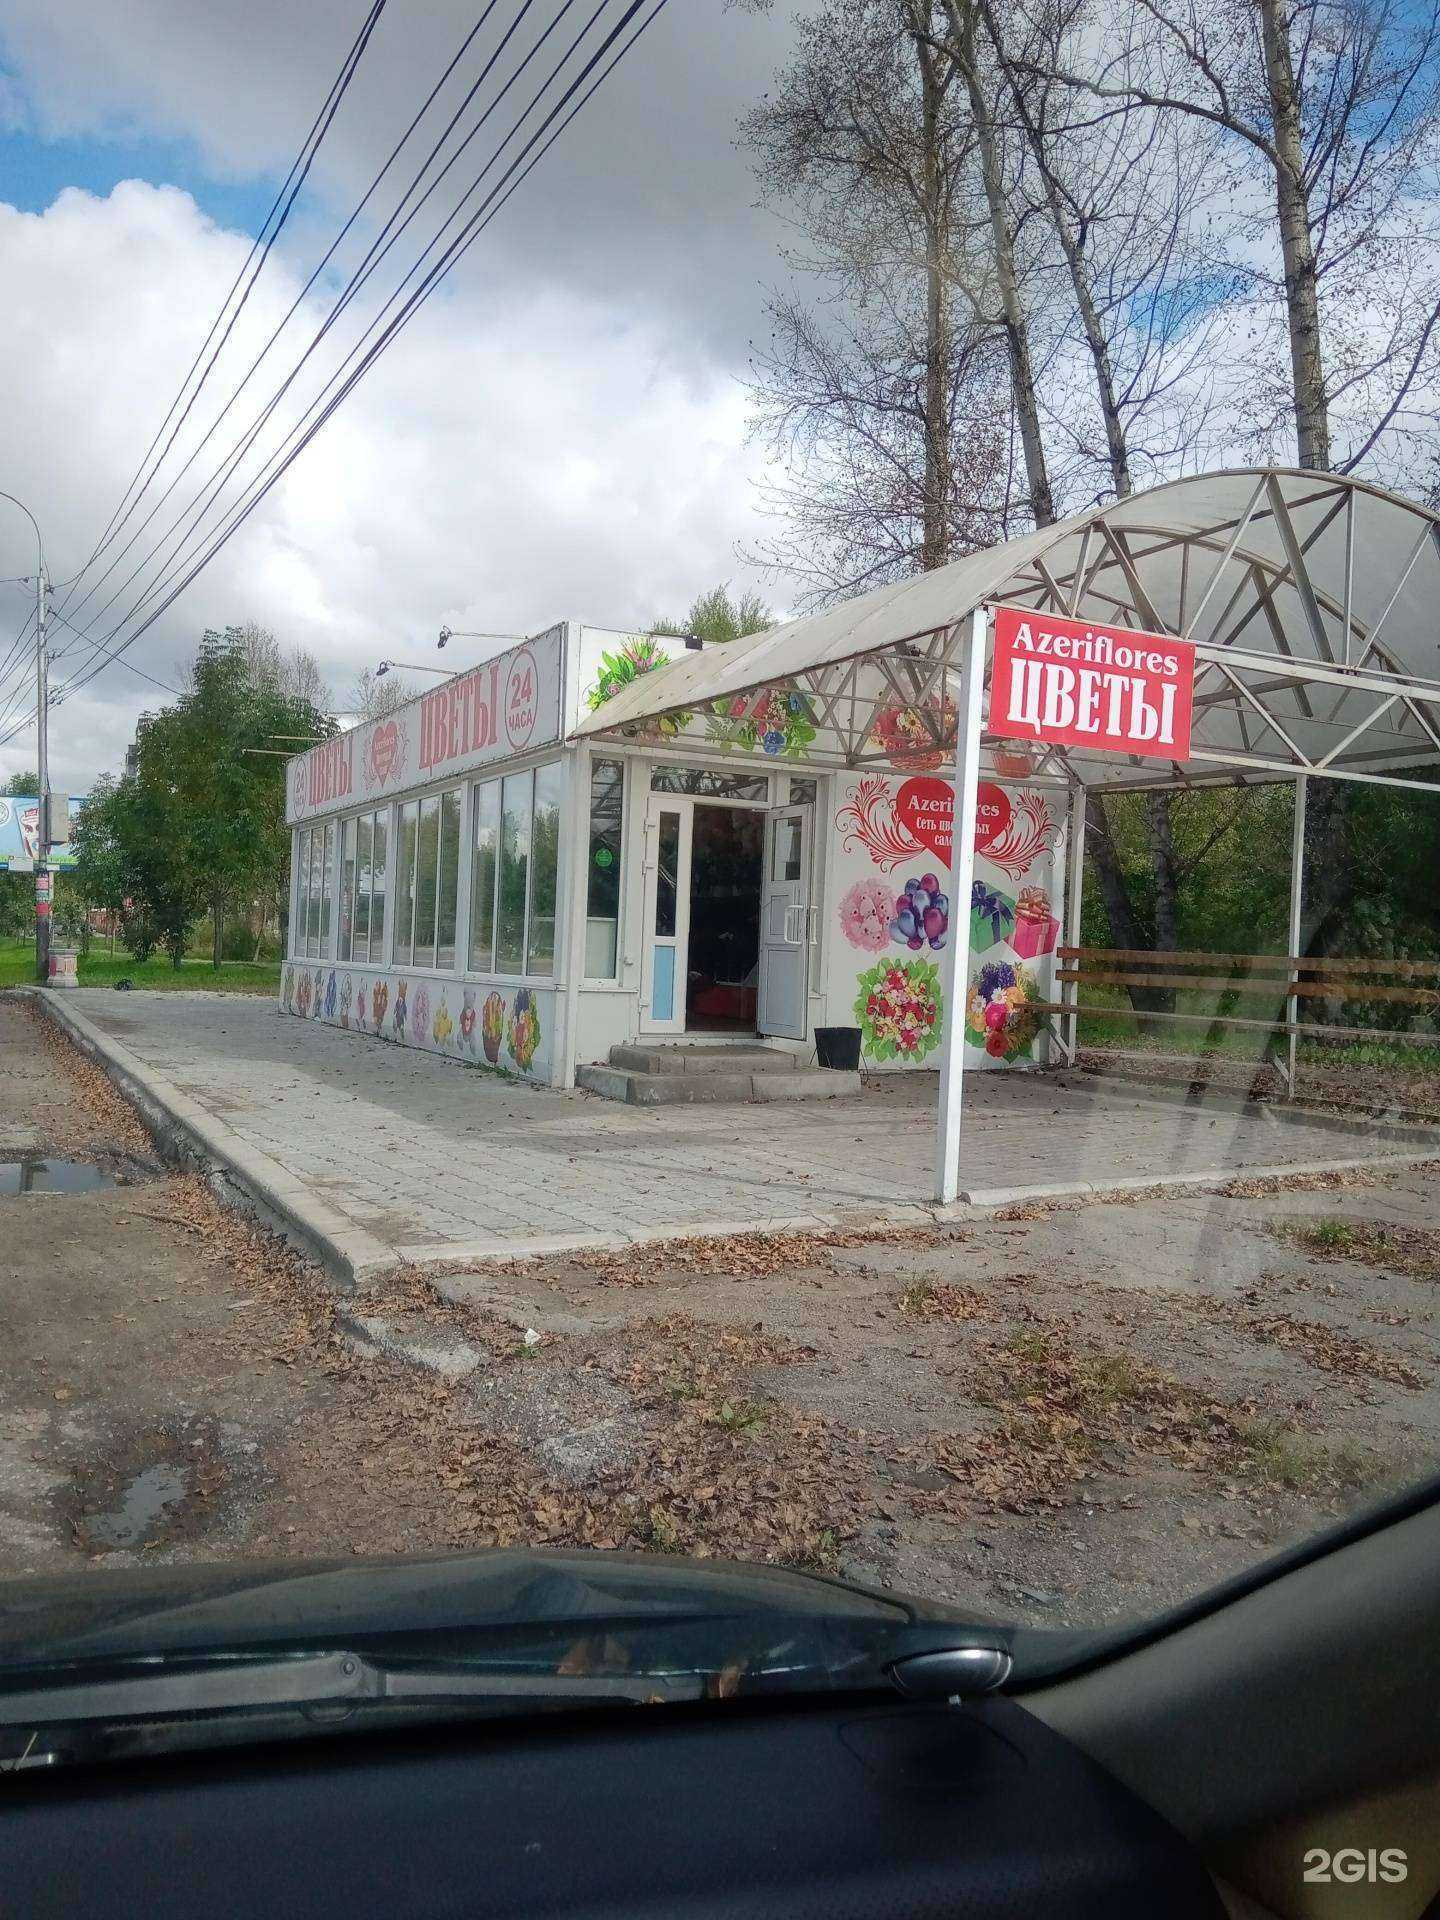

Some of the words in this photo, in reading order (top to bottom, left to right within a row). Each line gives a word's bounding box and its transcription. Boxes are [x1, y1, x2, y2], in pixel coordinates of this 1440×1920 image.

[1011, 622, 1179, 677] Azeriflores
[510, 667, 532, 709] 24
[1006, 657, 1178, 745] ЦВЕТЫ
[419, 663, 499, 777] ЦВЕТЫ
[508, 707, 533, 732] ЧАСА
[309, 734, 353, 813] ЦВЕТЫ
[907, 795, 1000, 817] Azeries
[916, 816, 937, 831] Сеть
